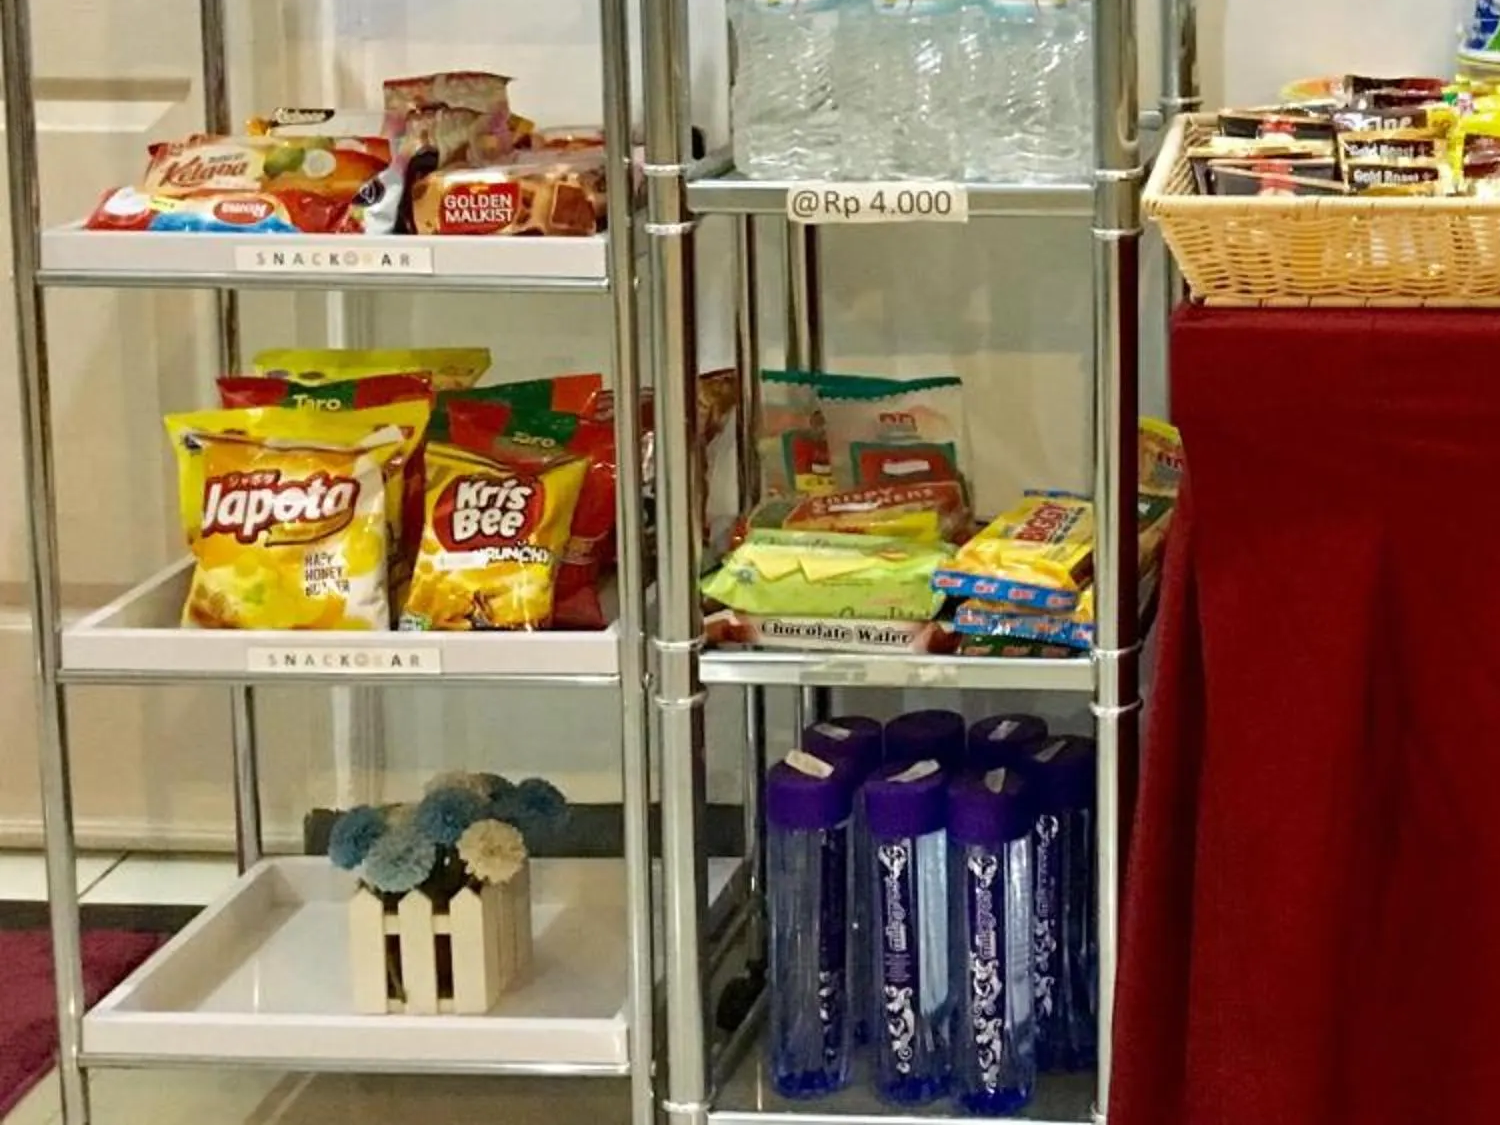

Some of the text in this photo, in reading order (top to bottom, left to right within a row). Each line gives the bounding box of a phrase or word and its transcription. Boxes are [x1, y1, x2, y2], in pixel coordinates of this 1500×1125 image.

[444, 194, 513, 209] GOLDEN
[869, 190, 952, 215] 4.000
[445, 208, 514, 223] MALKIST
[293, 394, 342, 412] Taro
[456, 478, 533, 510] Kris
[203, 478, 356, 536] Japota
[453, 507, 526, 543] Bee
[304, 569, 343, 582] HONEY
